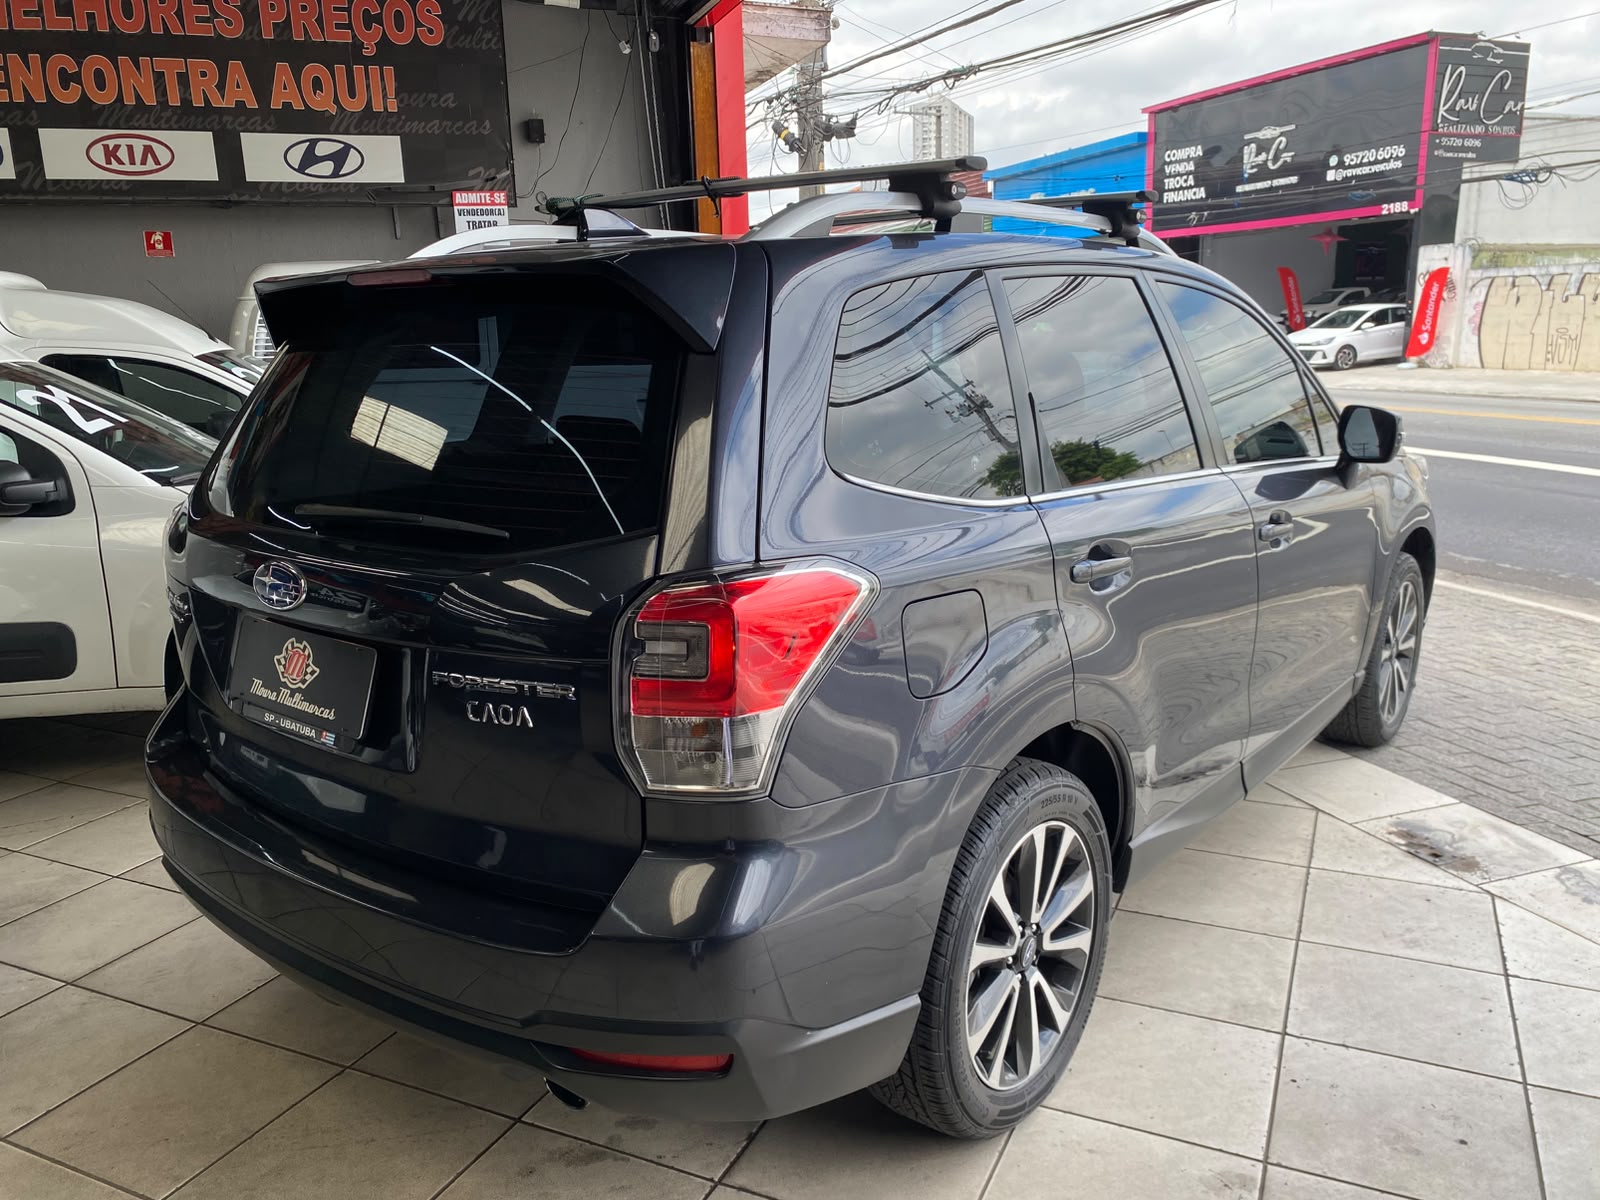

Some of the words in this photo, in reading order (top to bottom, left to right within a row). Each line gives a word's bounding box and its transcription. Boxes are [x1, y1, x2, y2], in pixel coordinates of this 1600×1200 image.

[0, 0, 244, 38] ELHORES
[259, 0, 444, 56] PREÇOS
[0, 53, 258, 108] NCONTRA
[270, 62, 398, 115] AQUI!
[325, 110, 493, 135] Multimarcas
[101, 143, 162, 166] KIA
[1164, 145, 1203, 162] COMPRA
[1343, 149, 1377, 166] 95720
[1377, 144, 1406, 160] 6096
[1164, 161, 1195, 176] VENDA
[1163, 175, 1195, 190] TROCA
[455, 192, 506, 204] ADMITE-SE
[1163, 187, 1206, 204] FINANCIA
[457, 208, 505, 217] VENDEDOR(A)
[1381, 201, 1409, 215] 2188
[1421, 281, 1440, 332] Santander
[432, 671, 576, 701] FORESTER
[250, 677, 277, 701] Moura
[277, 686, 336, 721] Multimarcas
[264, 712, 275, 724] SP
[280, 719, 316, 739] UBATUBA
